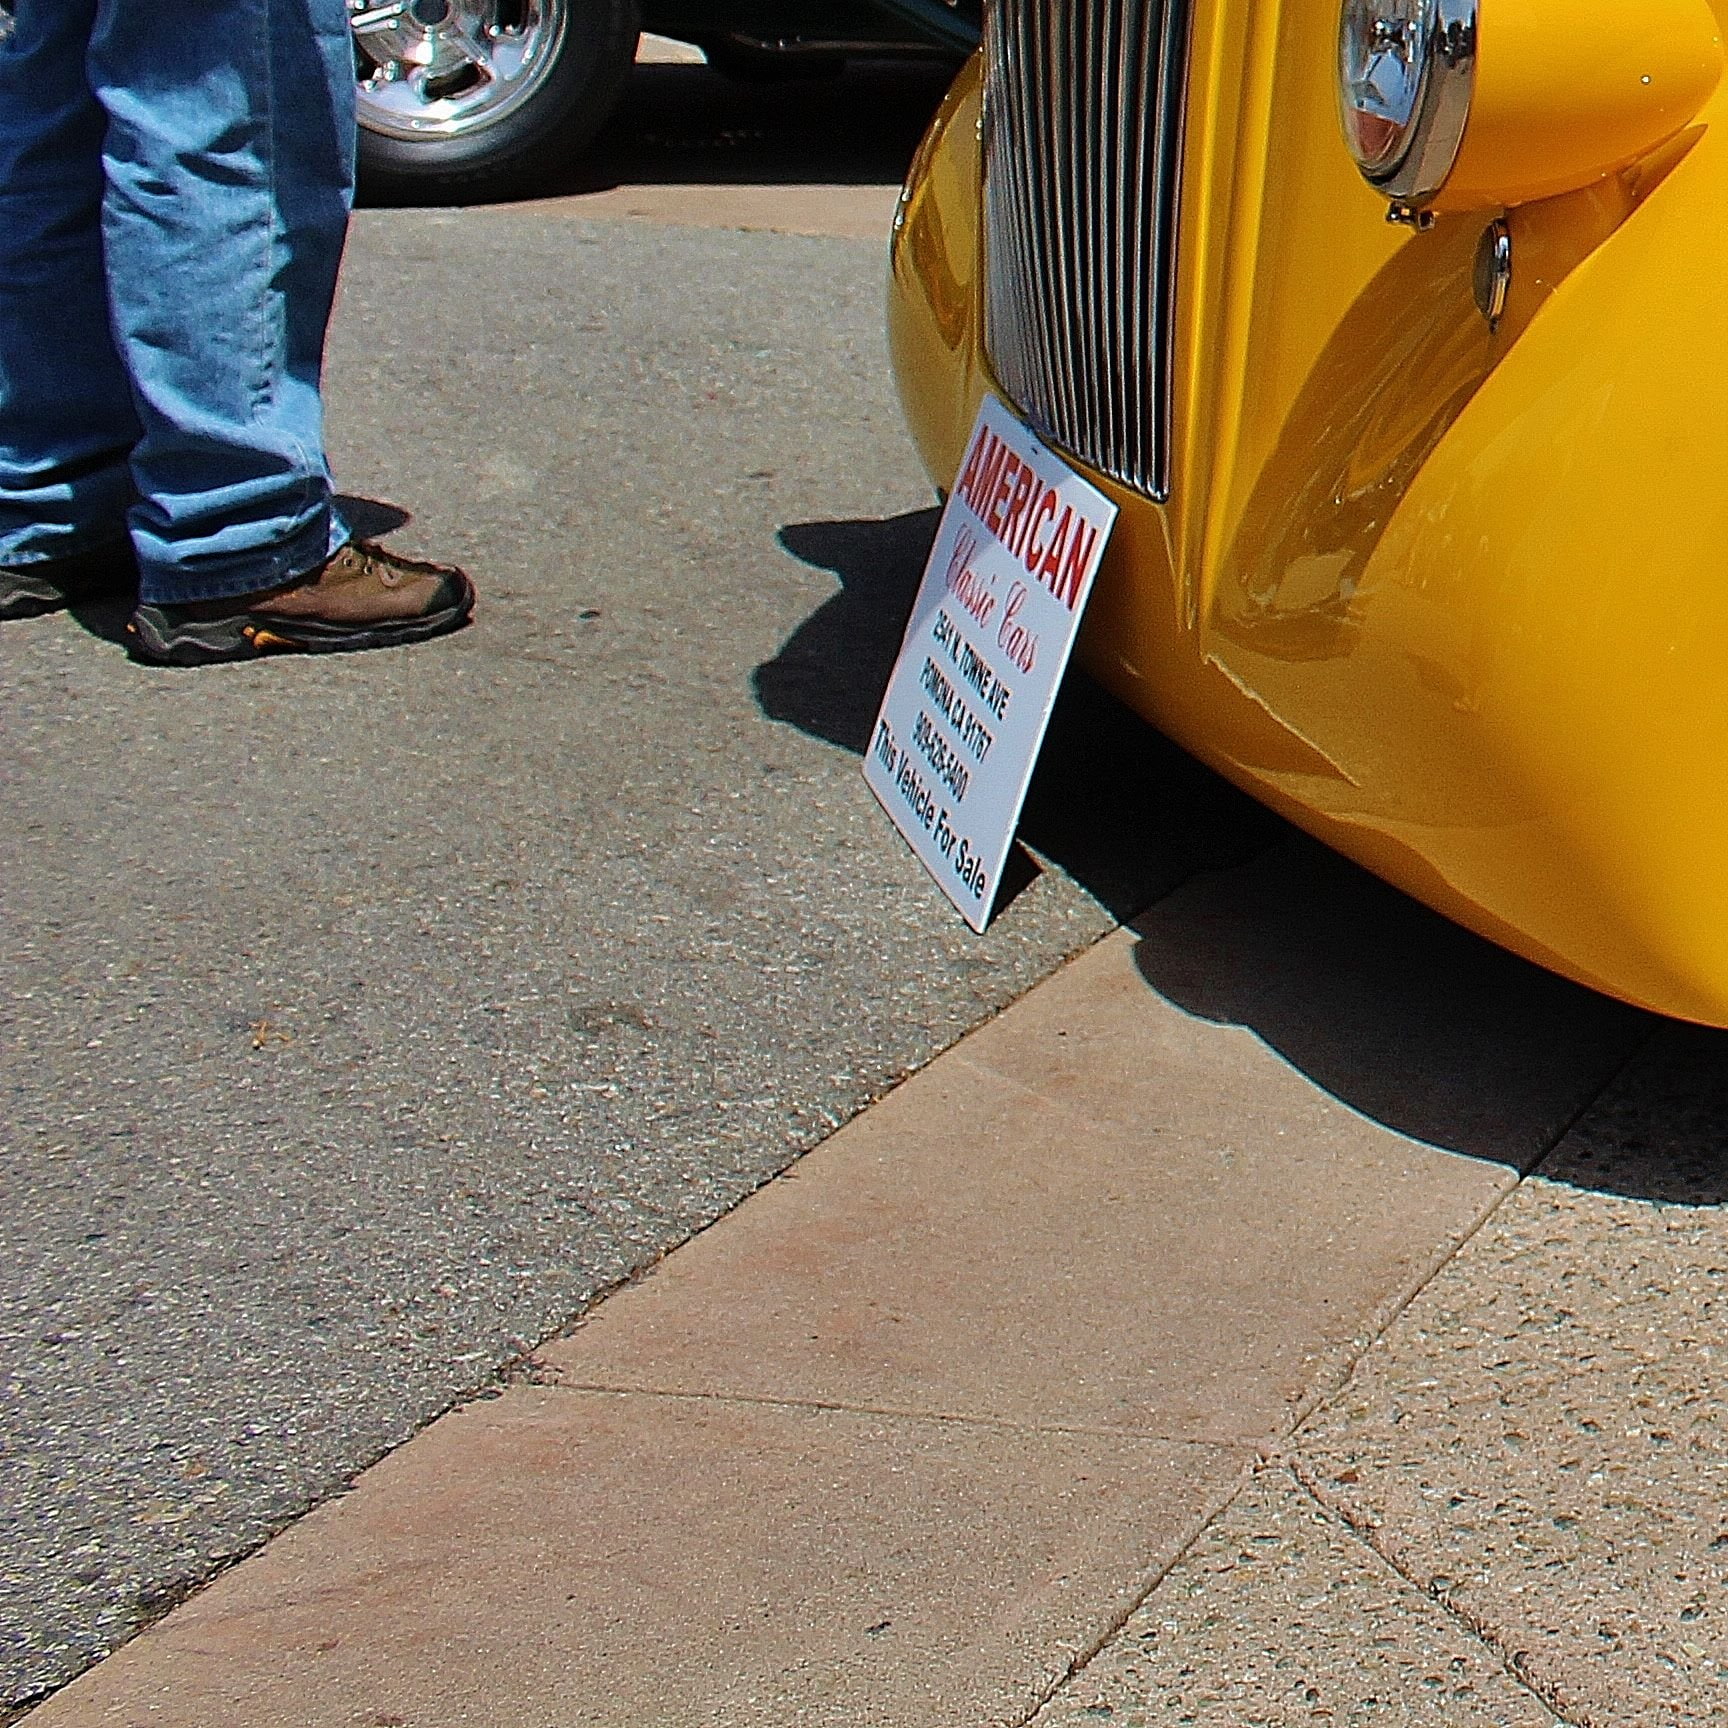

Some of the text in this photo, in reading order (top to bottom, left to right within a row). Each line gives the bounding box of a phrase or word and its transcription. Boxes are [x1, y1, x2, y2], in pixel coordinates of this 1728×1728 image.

[956, 422, 1098, 613] AMERICAN
[945, 522, 1040, 674] Classic Cars
[918, 655, 955, 719] POMONA
[949, 697, 967, 734] CA
[985, 676, 1010, 721] AVE
[873, 718, 987, 900] This Vehicle For Sale
